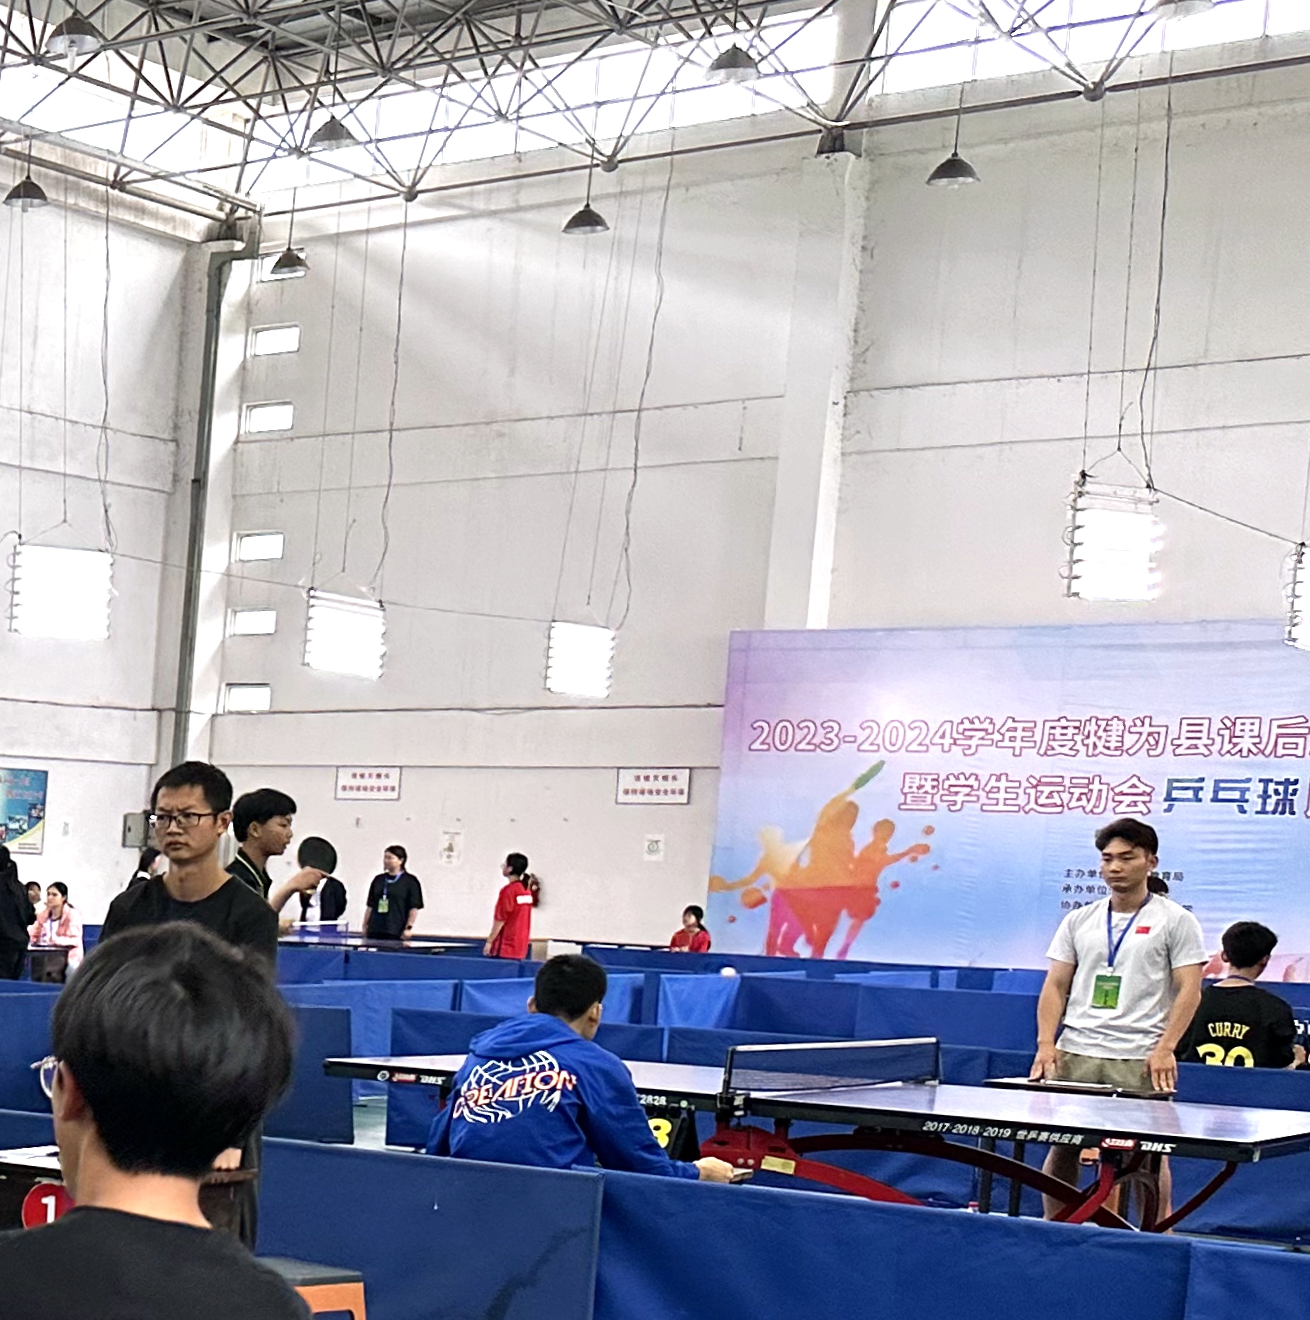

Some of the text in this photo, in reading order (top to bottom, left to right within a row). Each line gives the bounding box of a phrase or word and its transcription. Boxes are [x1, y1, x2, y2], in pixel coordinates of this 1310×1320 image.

[898, 772, 1299, 815] 暨学生运动会 乒乓球
[1064, 868, 1102, 879] 主办单
[1208, 1021, 1250, 1040] CURRY
[636, 1093, 667, 1106] 2828
[1140, 1141, 1177, 1153] DHS
[41, 1195, 56, 1223] 1
